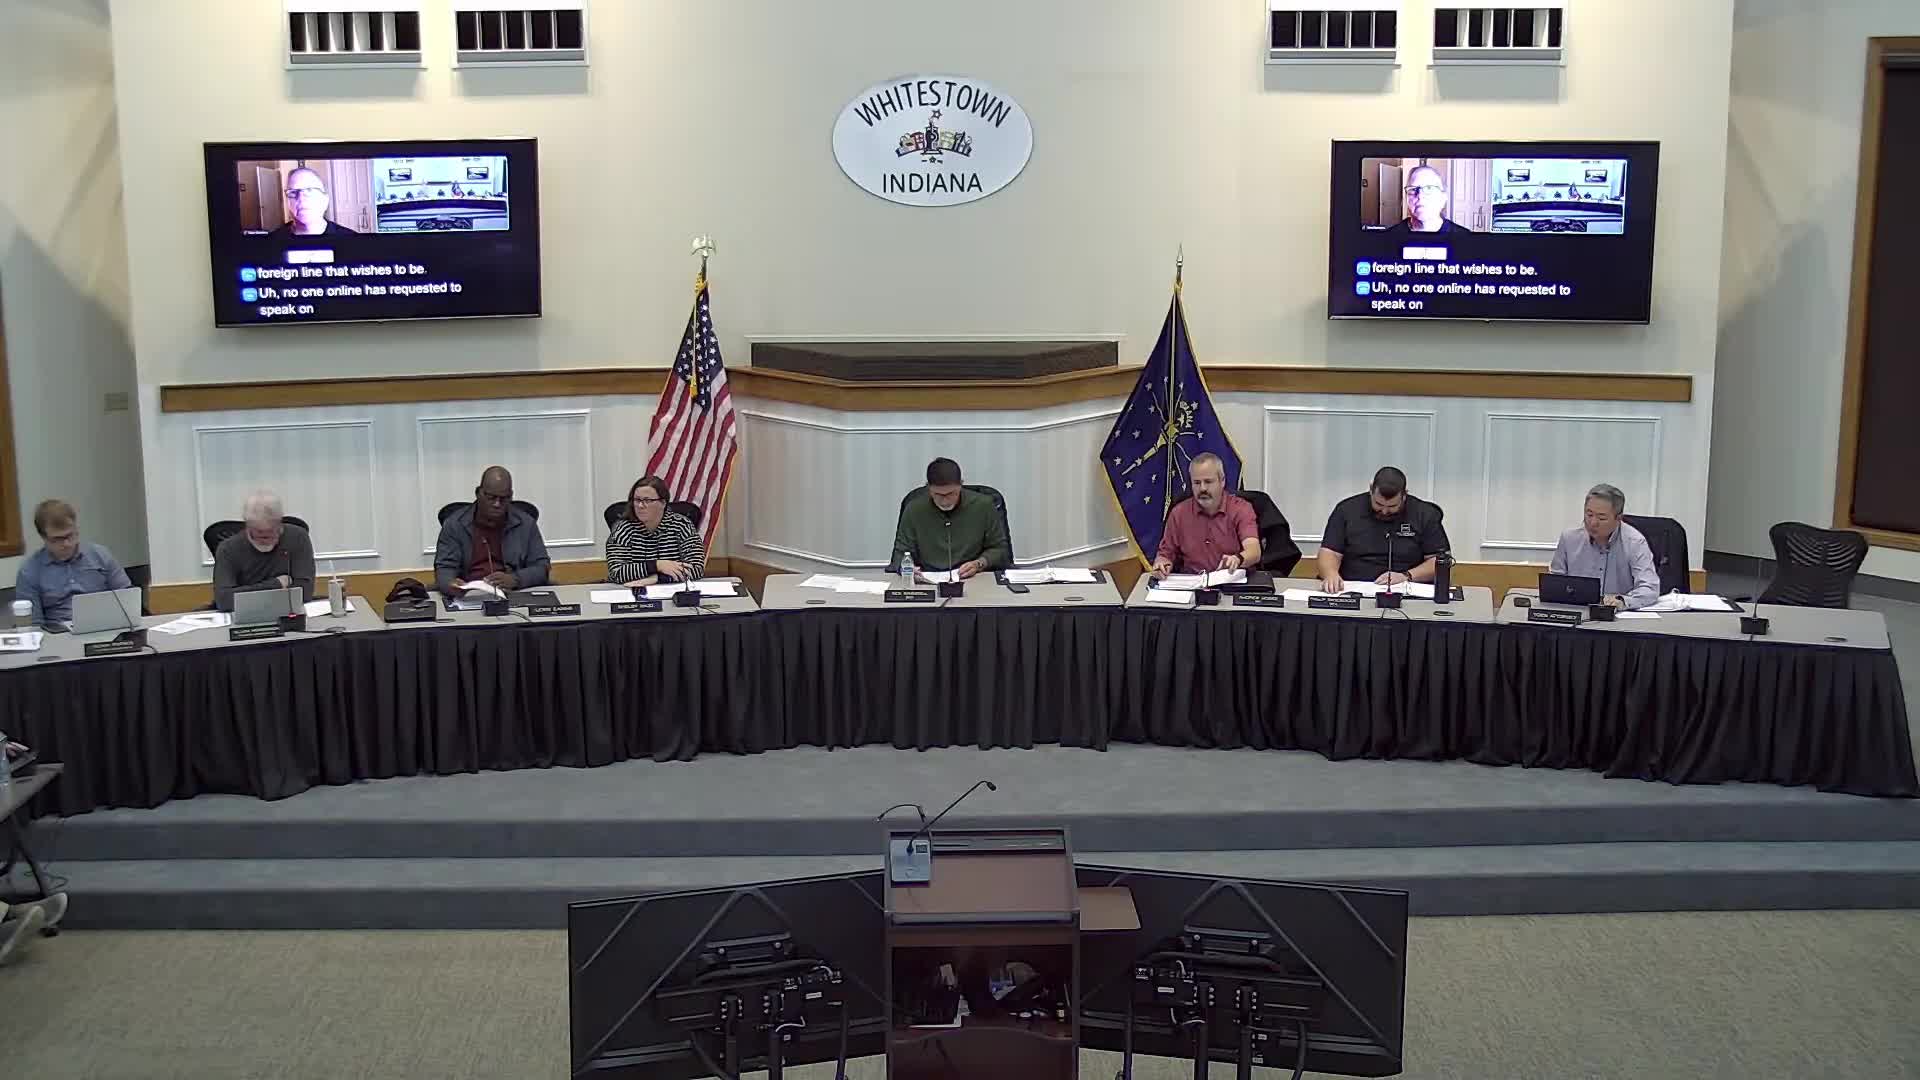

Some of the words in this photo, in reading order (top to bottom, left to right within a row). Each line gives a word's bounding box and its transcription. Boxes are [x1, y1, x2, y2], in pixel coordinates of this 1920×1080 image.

[854, 80, 1011, 128] WHITESTOWN
[883, 173, 983, 192] INDIANA
[257, 266, 298, 280] foreign
[301, 266, 322, 277] line
[325, 266, 348, 277] that
[351, 264, 391, 276] wishes
[394, 264, 406, 275] to
[408, 263, 427, 274] be.
[1372, 262, 1411, 275] foreign
[1415, 263, 1434, 274] line
[1438, 264, 1460, 274] that
[1463, 264, 1502, 275] wishes
[1505, 264, 1516, 275] to
[1520, 264, 1538, 275] be.
[259, 287, 280, 299] Uh,
[283, 288, 298, 297] no
[301, 288, 323, 297] one
[326, 285, 362, 297] online
[365, 284, 386, 295] has
[389, 282, 447, 296] requested
[450, 282, 462, 292] to
[1372, 281, 1391, 294] Uh,
[1395, 284, 1409, 292] no
[1413, 284, 1434, 294] one
[1437, 283, 1471, 294] online
[1475, 283, 1496, 294] has
[1499, 284, 1556, 297] requested
[1559, 285, 1571, 295] to
[260, 304, 296, 317] speak
[298, 305, 314, 314] on
[1371, 299, 1405, 311] speak
[1408, 301, 1423, 309] on
